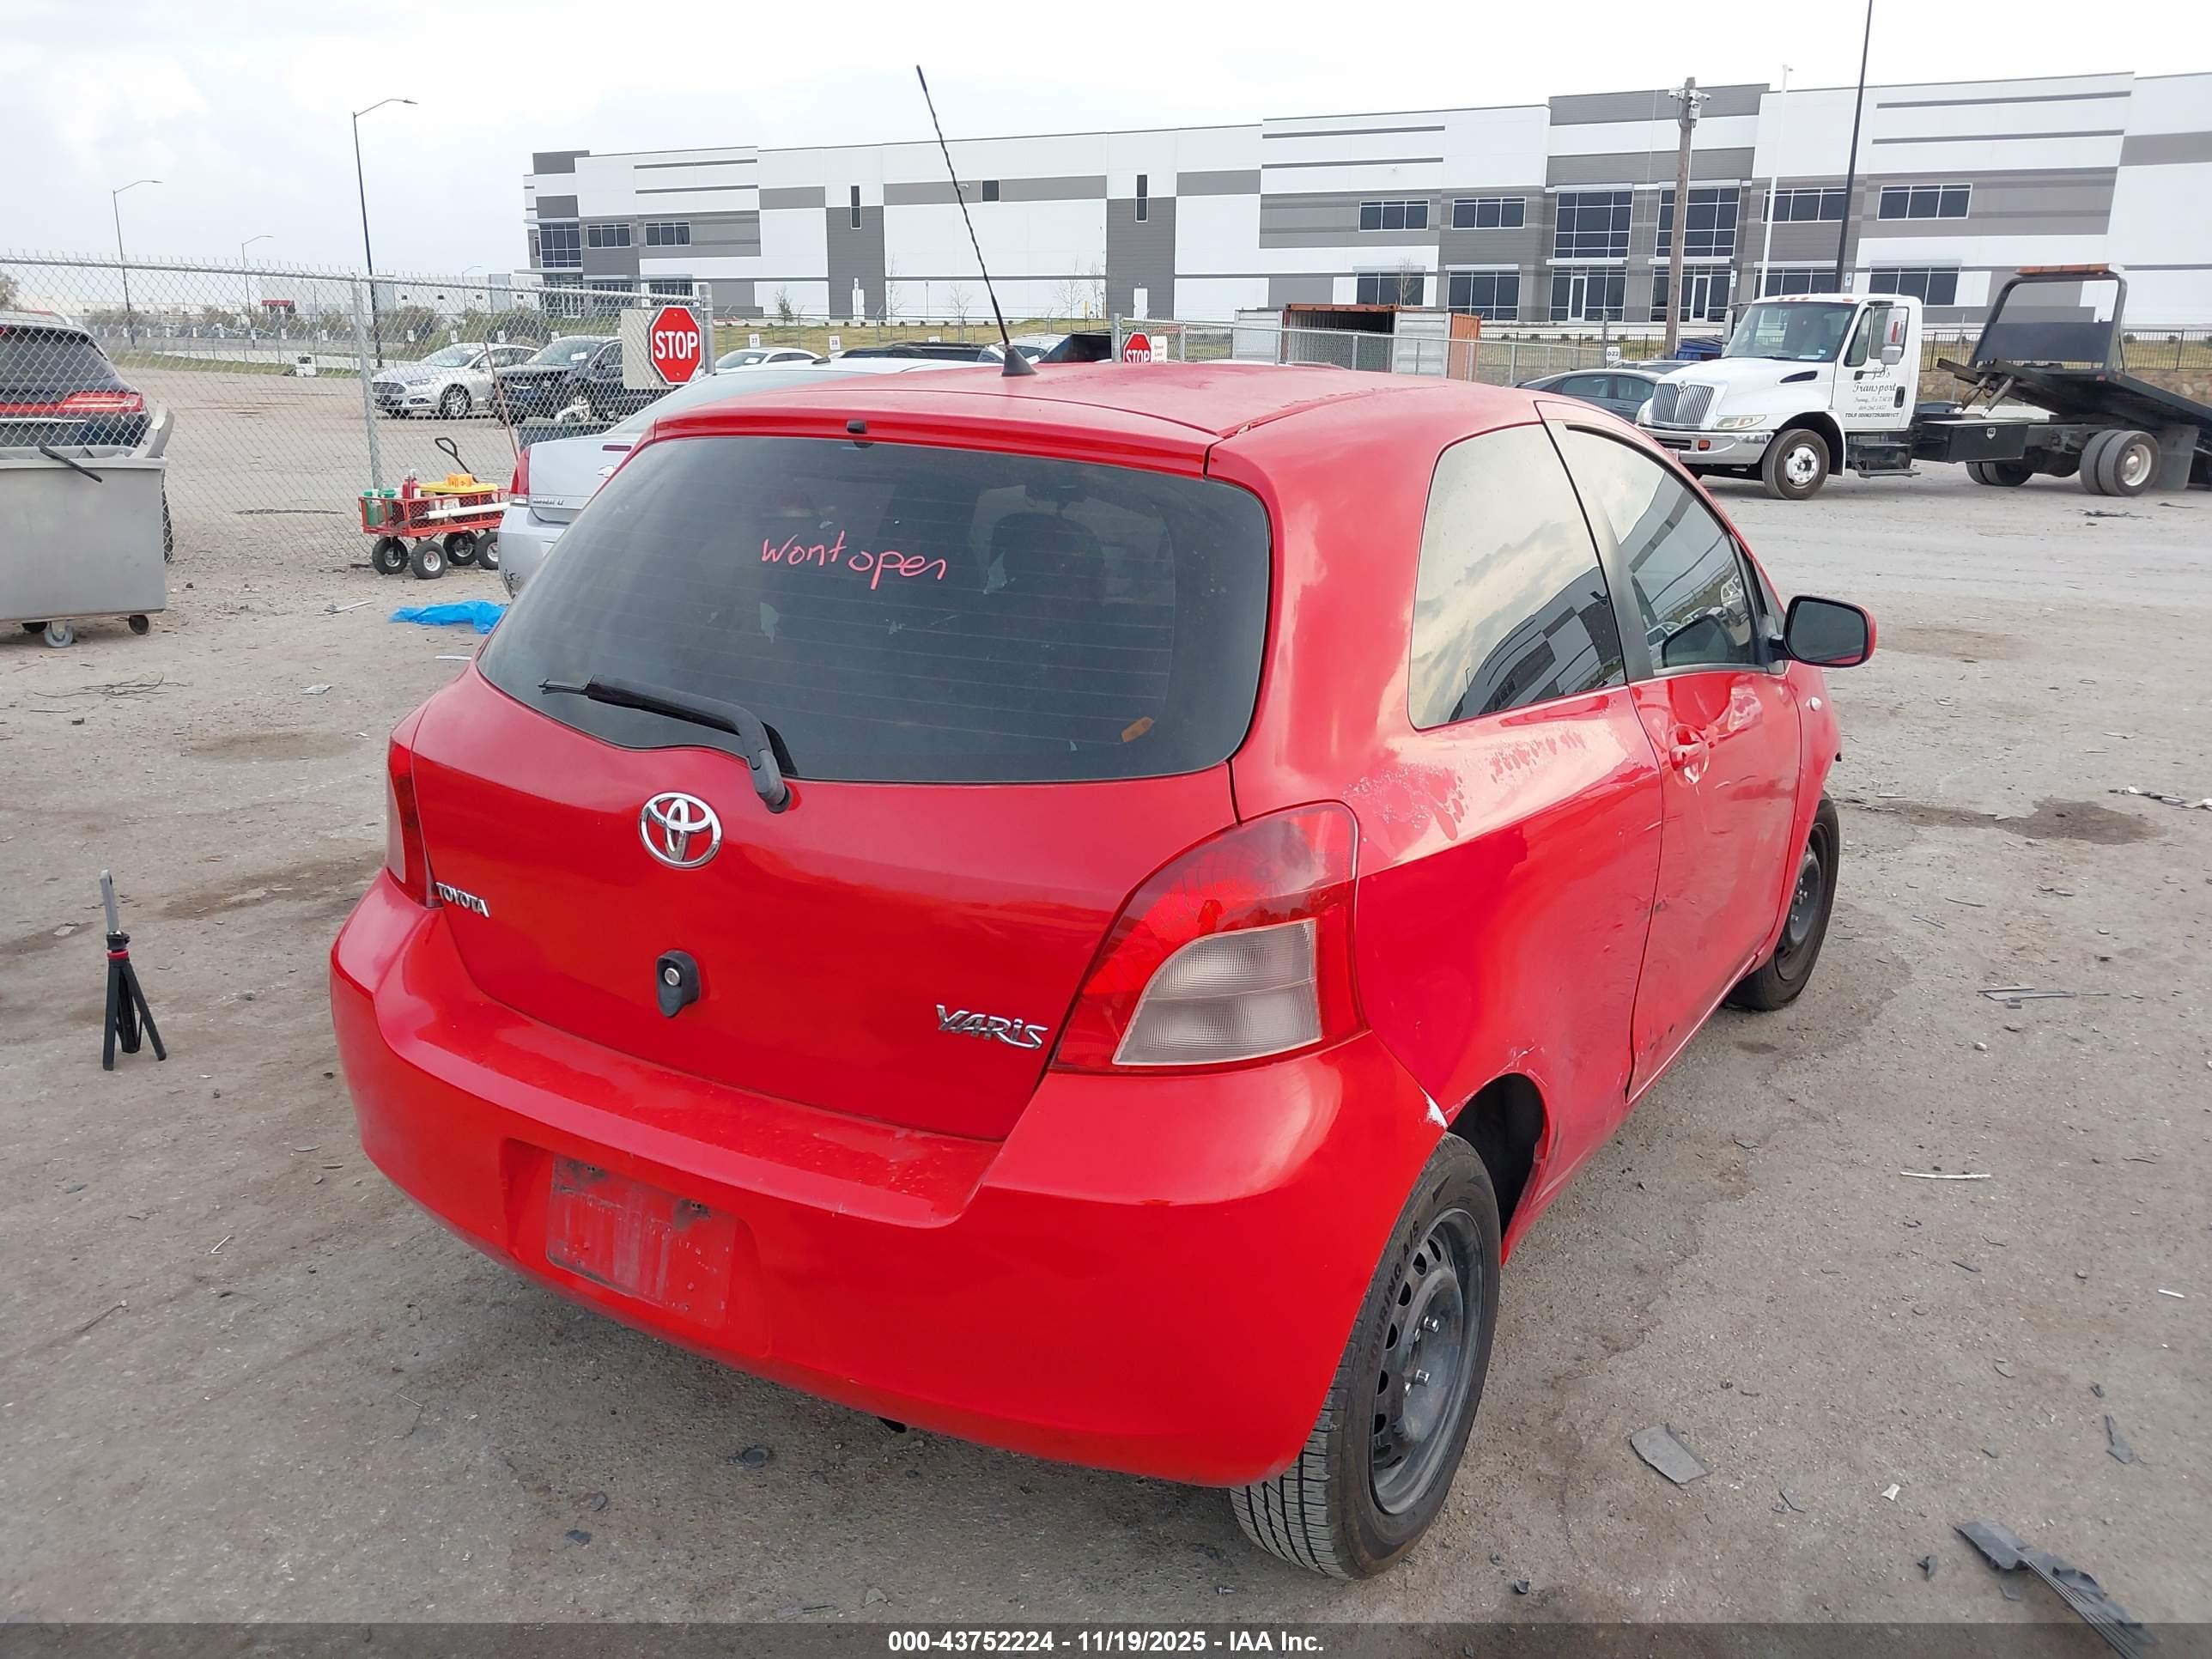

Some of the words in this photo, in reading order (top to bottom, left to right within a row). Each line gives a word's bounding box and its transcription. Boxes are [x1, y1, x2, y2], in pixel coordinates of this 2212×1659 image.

[654, 330, 698, 360] STOP
[1126, 349, 1151, 362] STOP
[1852, 381, 1897, 395] Transport
[848, 550, 947, 590] open
[435, 881, 490, 918] TOYOTA
